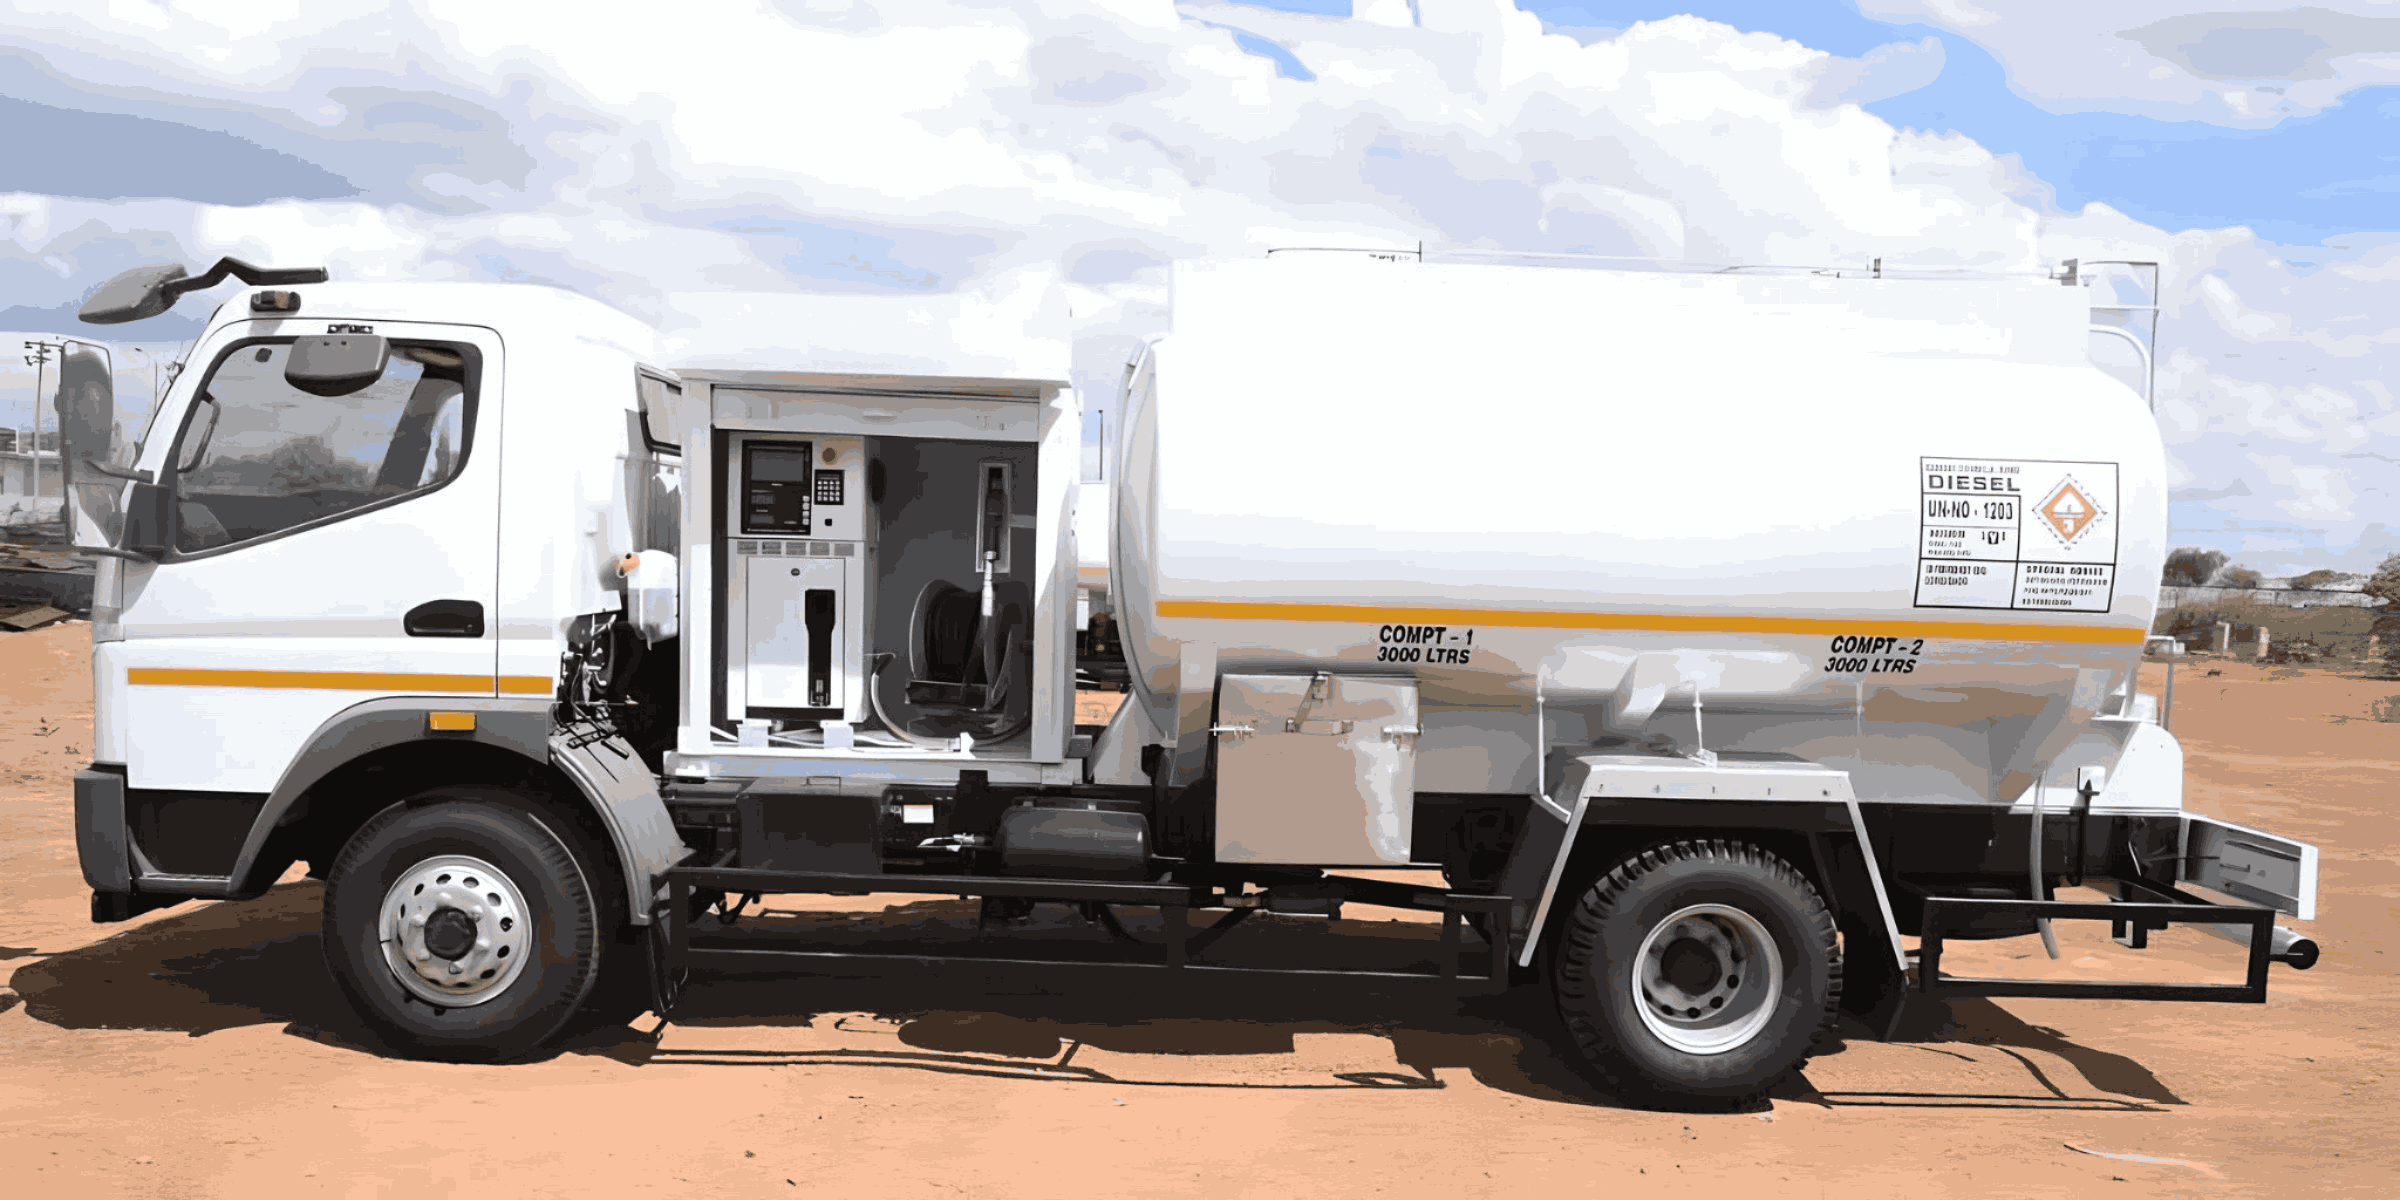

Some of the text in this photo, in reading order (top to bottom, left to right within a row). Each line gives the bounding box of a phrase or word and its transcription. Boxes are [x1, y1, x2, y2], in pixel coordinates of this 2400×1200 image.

[1928, 474, 2021, 492] DIESEL
[1379, 625, 1447, 645] COMPT
[1466, 628, 1474, 646] 1
[1830, 635, 1898, 655] COMPT
[1909, 639, 1924, 656] 2
[1377, 646, 1471, 665] 3000 LTRS
[1824, 657, 1917, 674] 3000 LTRS
